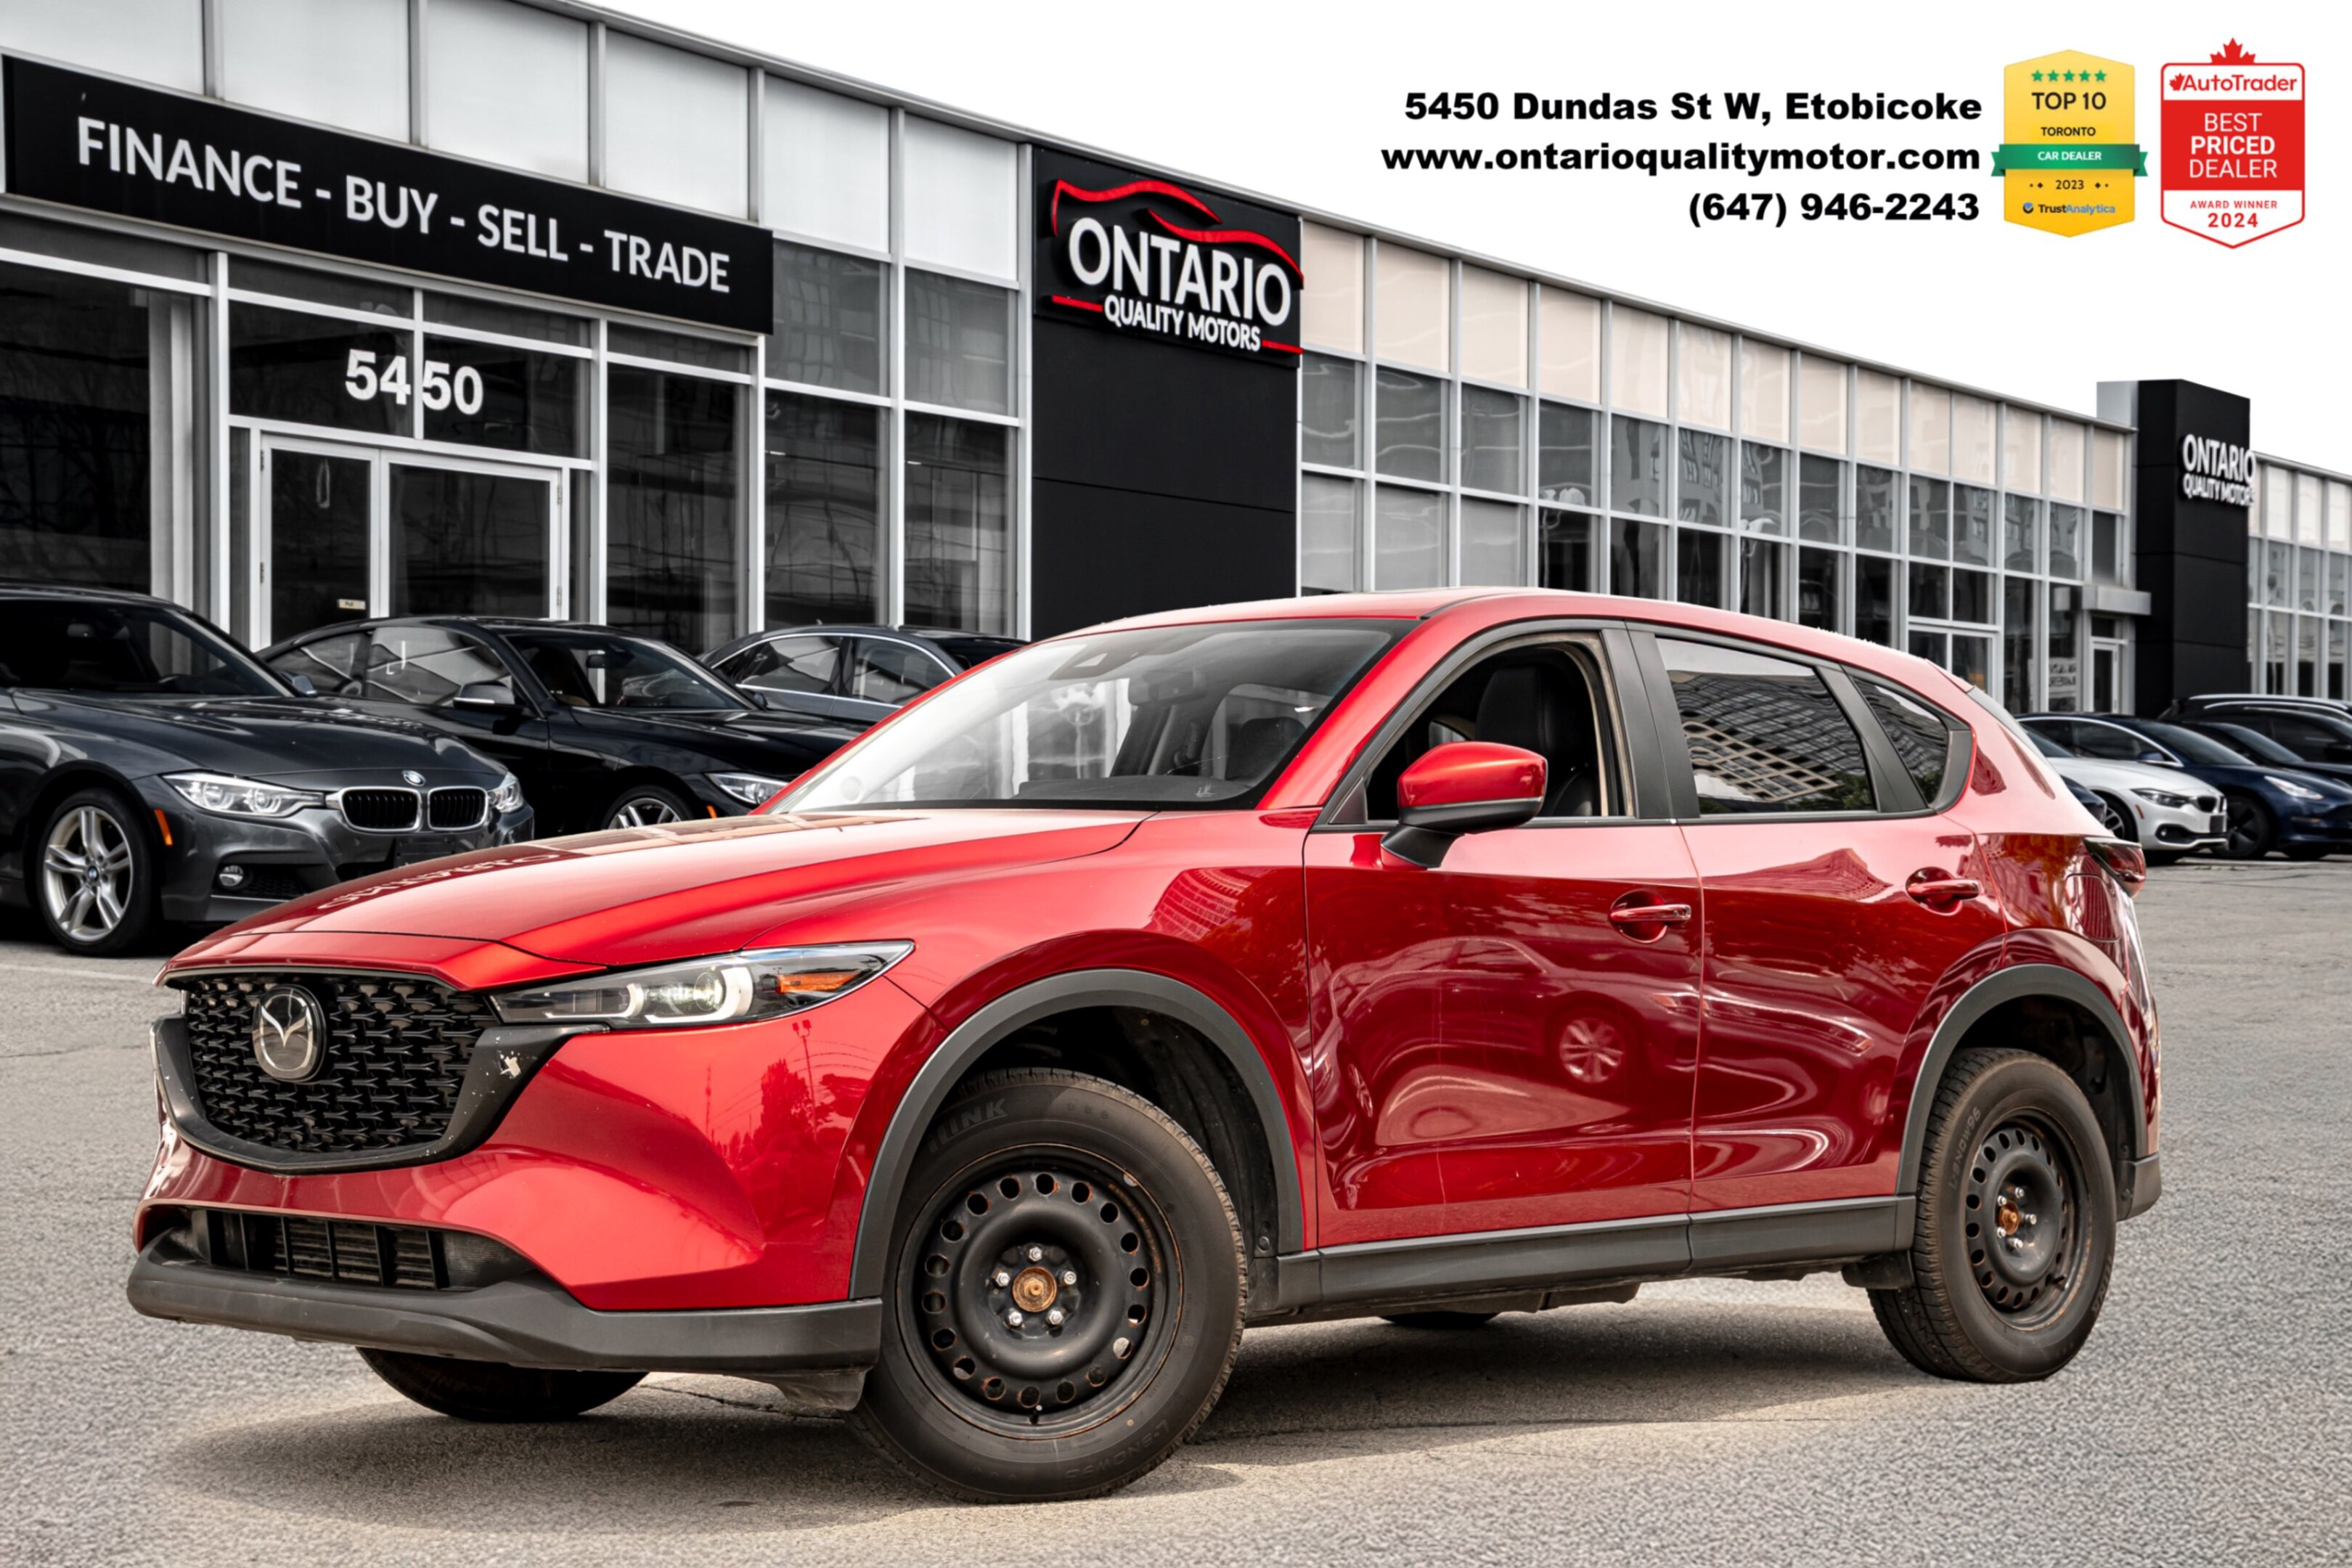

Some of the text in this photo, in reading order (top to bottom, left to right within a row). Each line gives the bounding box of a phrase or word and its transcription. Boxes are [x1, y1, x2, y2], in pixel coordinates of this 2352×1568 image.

[77, 115, 731, 294] FINANCE - BUY - SELL - TRADE
[1069, 217, 1291, 327] ONTARIO
[1103, 294, 1262, 352] QUALITY MOTORS
[346, 349, 483, 415] 5450
[2182, 433, 2257, 485] ONTARIO
[2182, 473, 2221, 499] QUALITY
